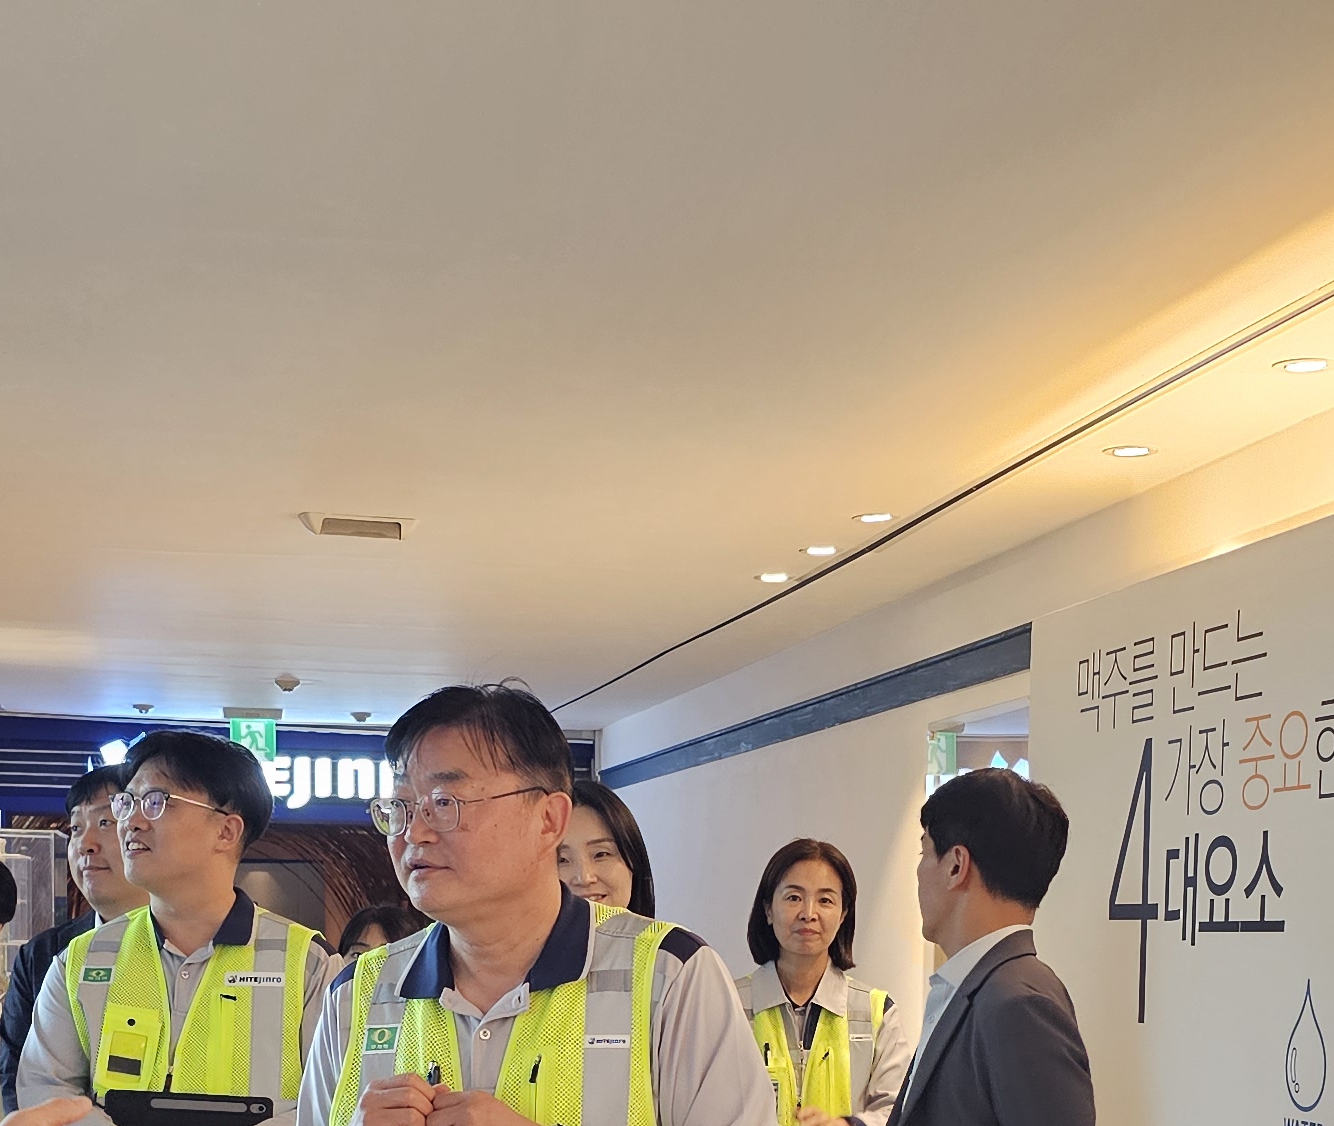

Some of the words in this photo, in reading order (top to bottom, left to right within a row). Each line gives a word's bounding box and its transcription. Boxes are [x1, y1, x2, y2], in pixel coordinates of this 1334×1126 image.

[1077, 637, 1158, 732] 맥주를
[1169, 610, 1267, 714] 만드는
[1164, 719, 1230, 816] 가장
[1108, 738, 1159, 1024] 4
[1164, 830, 1285, 946] 대요소
